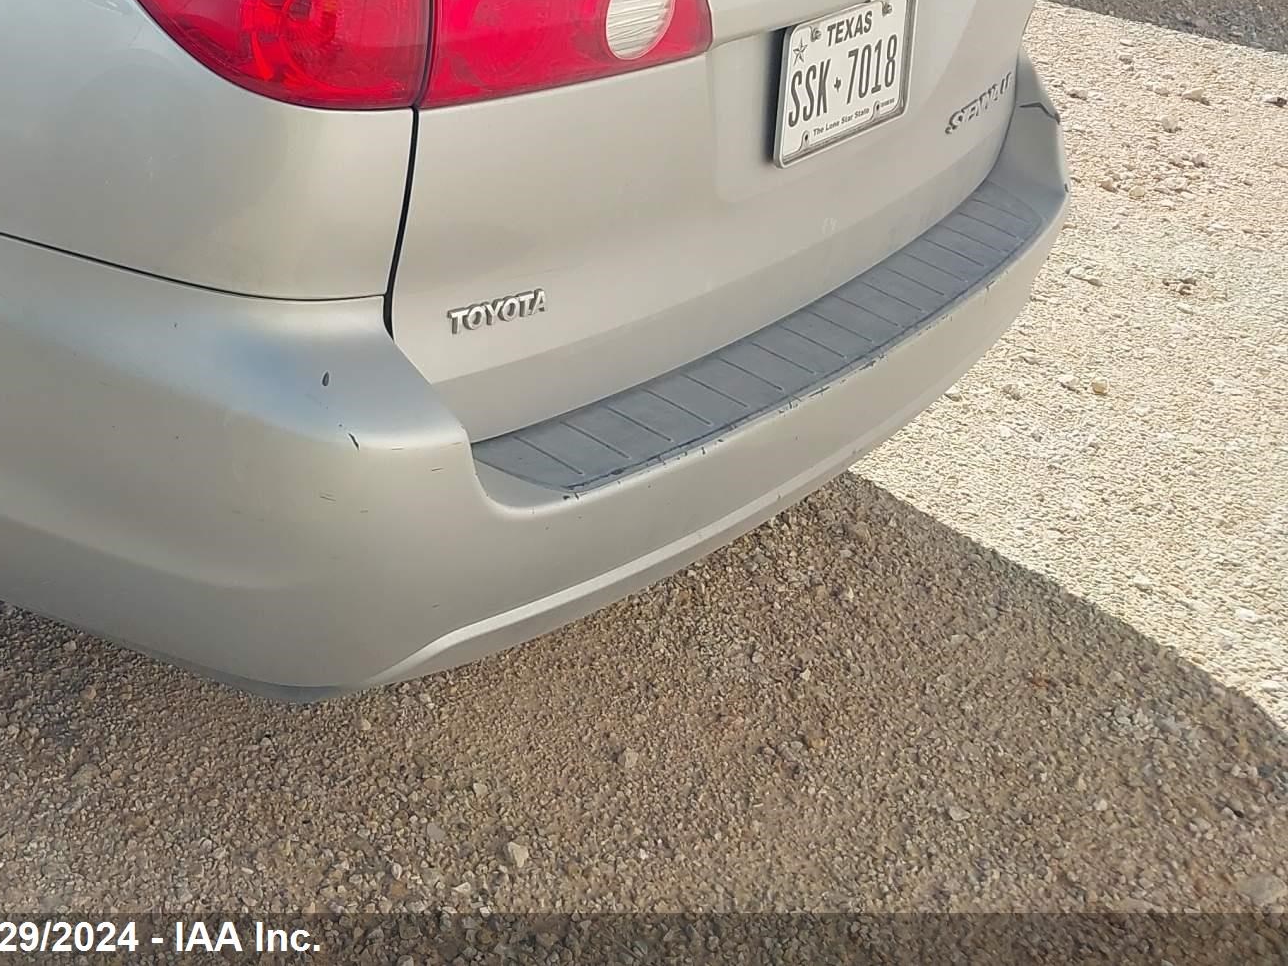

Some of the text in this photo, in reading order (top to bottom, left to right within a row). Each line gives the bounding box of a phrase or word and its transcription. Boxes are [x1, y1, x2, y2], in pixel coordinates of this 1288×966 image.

[826, 10, 873, 47] TEXAS
[788, 34, 898, 127] SSK 7018
[813, 126, 825, 136] The
[825, 120, 840, 131] Lone
[841, 113, 854, 125] Star
[446, 287, 547, 335] TOYOTA
